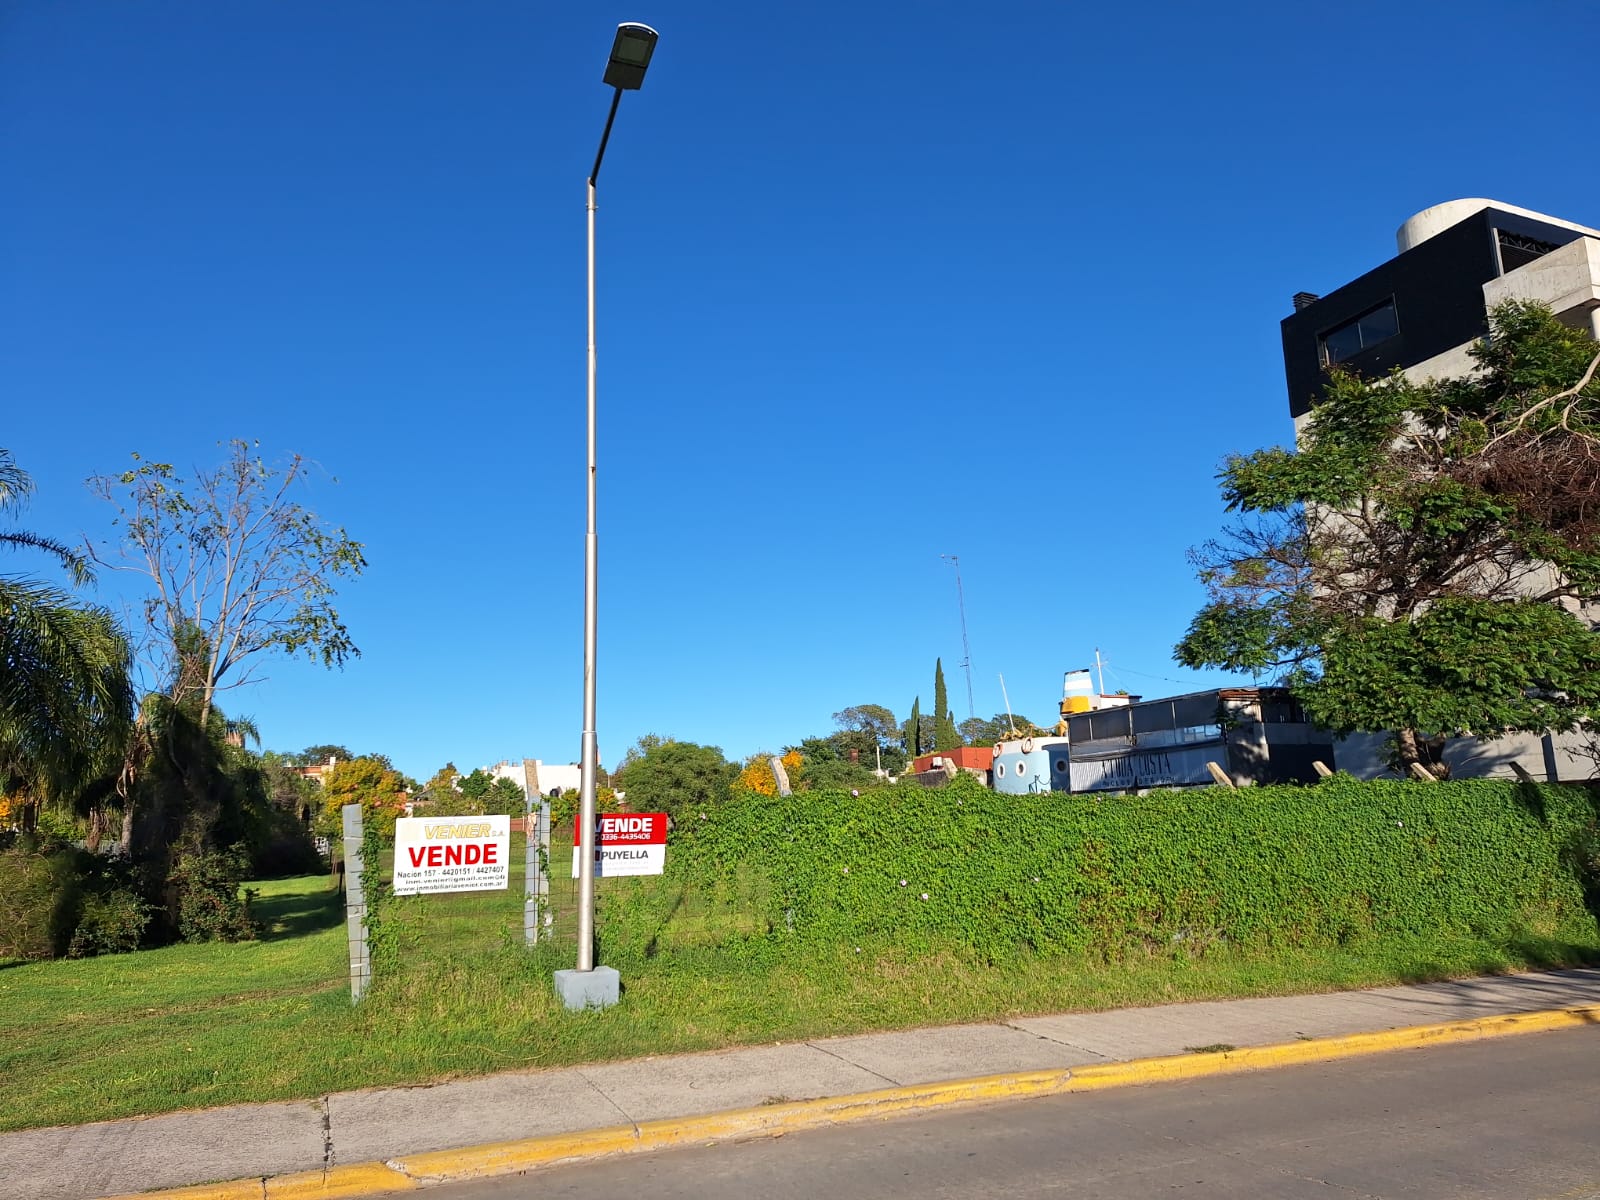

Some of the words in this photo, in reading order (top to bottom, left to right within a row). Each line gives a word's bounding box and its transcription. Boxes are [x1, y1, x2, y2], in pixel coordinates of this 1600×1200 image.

[424, 824, 491, 839] VENIER
[595, 818, 653, 832] VENDE
[408, 843, 497, 868] VENDE
[602, 850, 649, 860] PUYELLA
[442, 867, 471, 875] 4420151
[476, 866, 505, 874] 4427407
